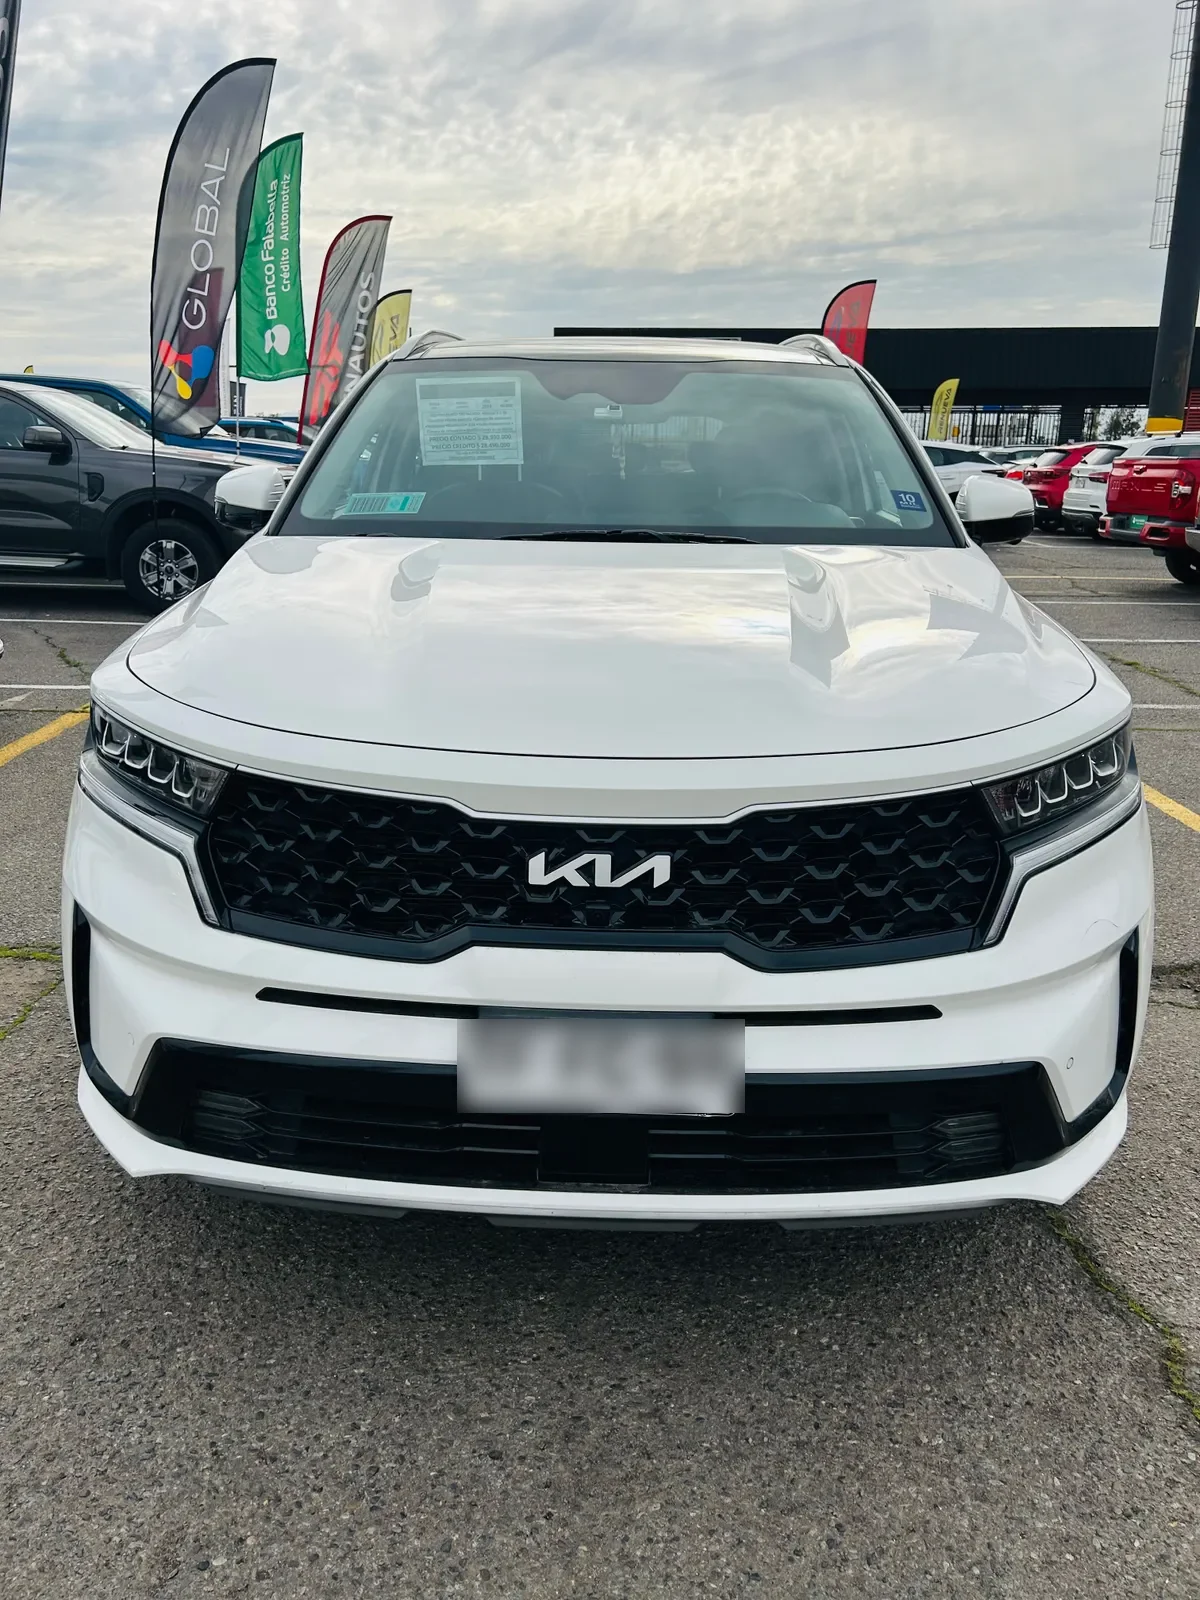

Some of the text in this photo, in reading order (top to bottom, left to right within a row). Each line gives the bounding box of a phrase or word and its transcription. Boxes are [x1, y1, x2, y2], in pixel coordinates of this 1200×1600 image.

[182, 147, 230, 330] GLOBAL
[261, 178, 279, 320] Banco Falabella
[279, 172, 292, 292] Crédito Automotriz
[528, 851, 671, 889] KIA
